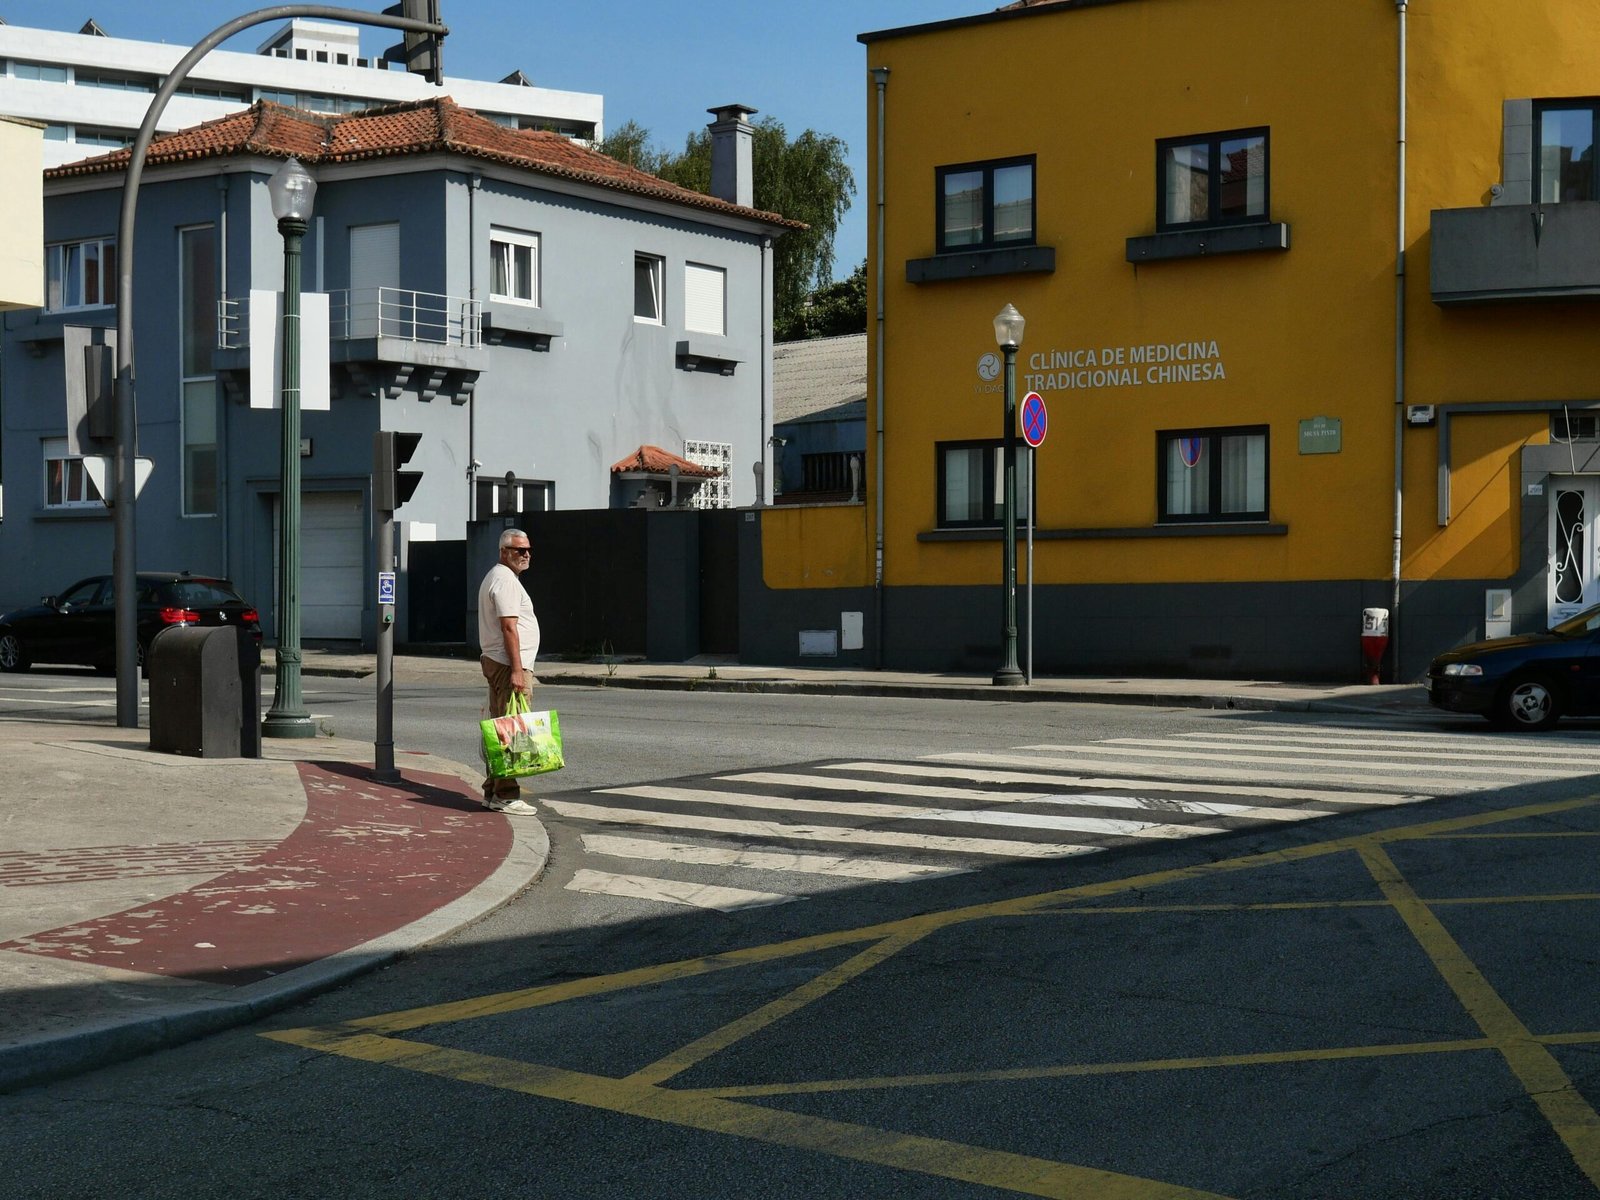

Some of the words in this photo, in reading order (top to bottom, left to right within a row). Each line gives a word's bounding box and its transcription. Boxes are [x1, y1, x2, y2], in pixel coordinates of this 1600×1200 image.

[1029, 348, 1097, 371] CLÍNICA
[1101, 347, 1125, 366] DE
[1129, 340, 1220, 364] MEDICINA
[1024, 368, 1142, 391] TRADICIONAL
[1146, 362, 1226, 385] CHINESA
